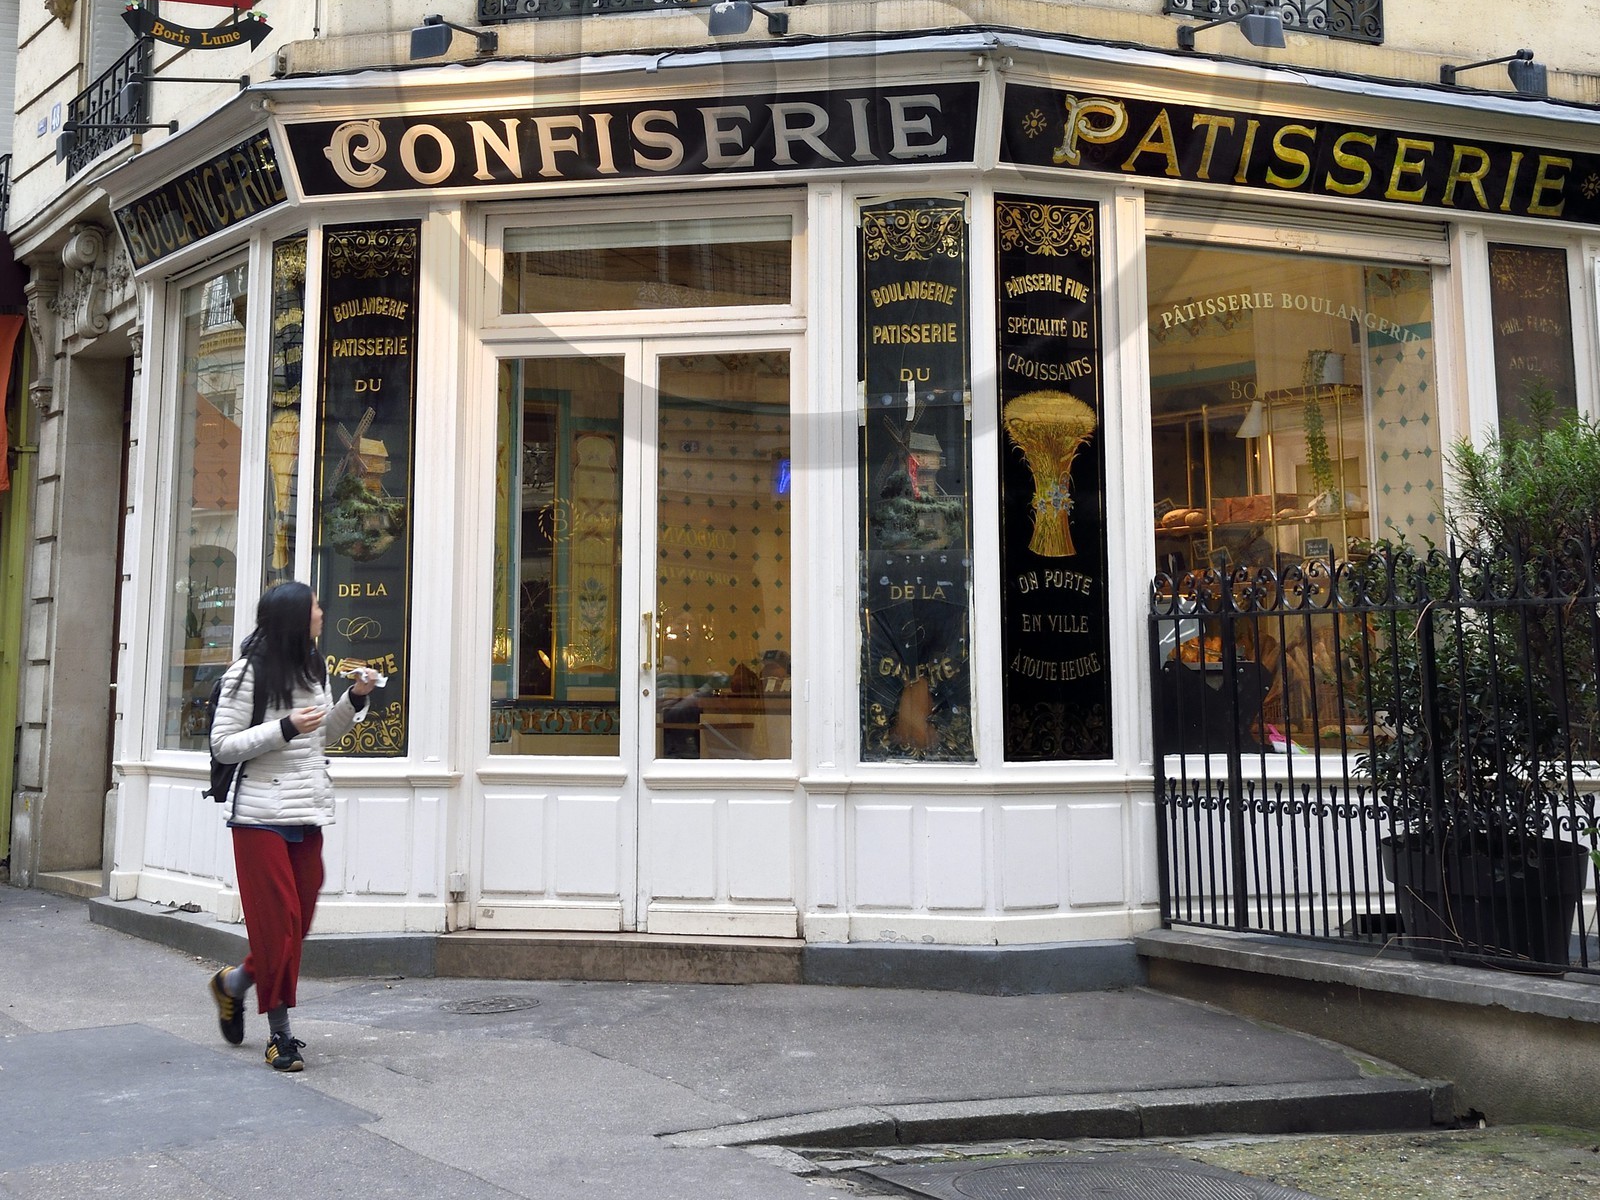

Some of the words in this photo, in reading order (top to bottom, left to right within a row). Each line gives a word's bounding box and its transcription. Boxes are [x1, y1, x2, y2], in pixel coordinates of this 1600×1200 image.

[151, 21, 191, 44] Boris
[323, 93, 950, 188] CONFISERIE
[1052, 93, 1573, 217] PATISSERIE
[124, 138, 287, 266] BOULANGERIE
[871, 280, 957, 308] BOULANGERIE
[1065, 277, 1090, 304] FINE
[333, 296, 409, 323] BOULANGERIE
[1161, 292, 1274, 330] PÂTISSERIE
[872, 323, 957, 344] PATISSERIE
[1007, 314, 1068, 338] SPÉCIALITÉ
[1072, 320, 1088, 339] DE
[332, 336, 408, 358] PATISSERIE
[900, 367, 931, 382] DU
[1007, 352, 1092, 382] CROISSANTS
[354, 378, 382, 393] DU
[338, 583, 361, 598] DE
[366, 583, 387, 597] LA
[891, 585, 915, 600] DE
[922, 585, 946, 600] LA
[1018, 571, 1039, 594] ON
[1045, 568, 1093, 596] PORTE
[1022, 614, 1042, 633] EN
[1048, 614, 1089, 633] VILLE
[326, 653, 398, 679] GATTE
[1021, 655, 1057, 681] TOUTE
[1061, 652, 1101, 681] HEURE
